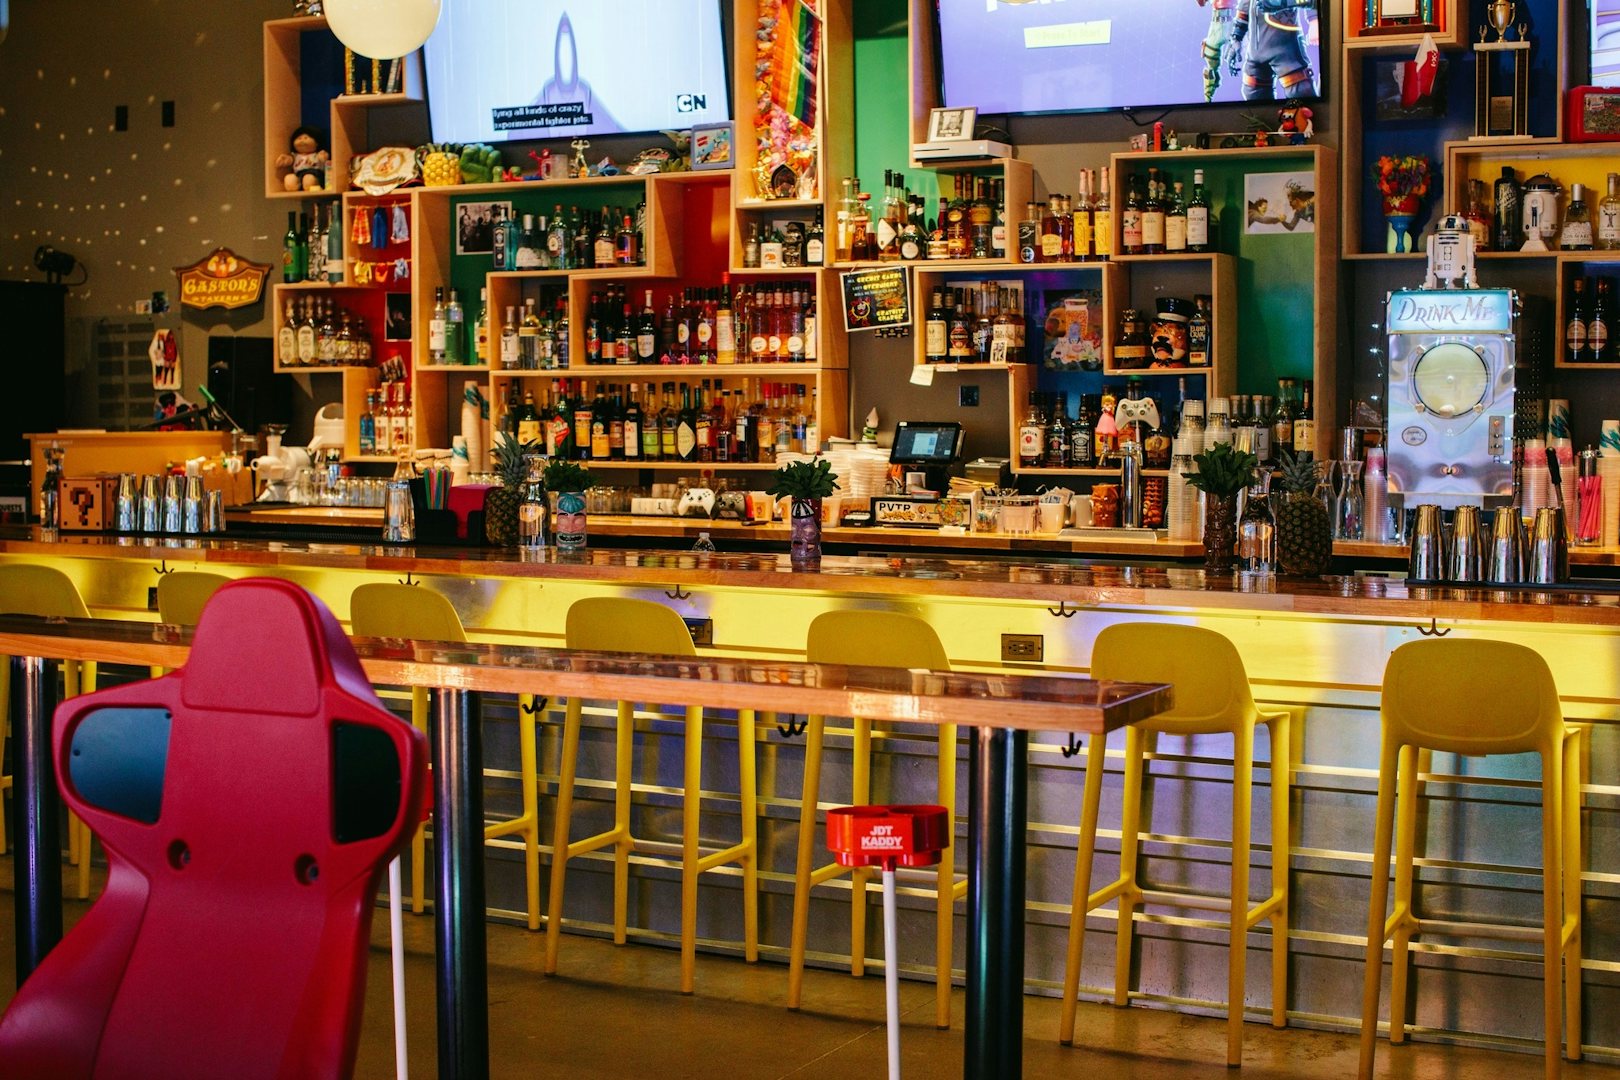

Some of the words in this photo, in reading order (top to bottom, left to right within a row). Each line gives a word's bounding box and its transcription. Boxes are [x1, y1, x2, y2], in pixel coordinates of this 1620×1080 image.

[677, 94, 707, 112] CN
[514, 108, 524, 117] all
[558, 105, 582, 113] crazy
[184, 276, 258, 295] GASTON'S
[1397, 297, 1461, 330] DRINK
[1461, 296, 1494, 320] ME
[870, 825, 893, 836] JDT
[861, 836, 903, 847] KADDY
